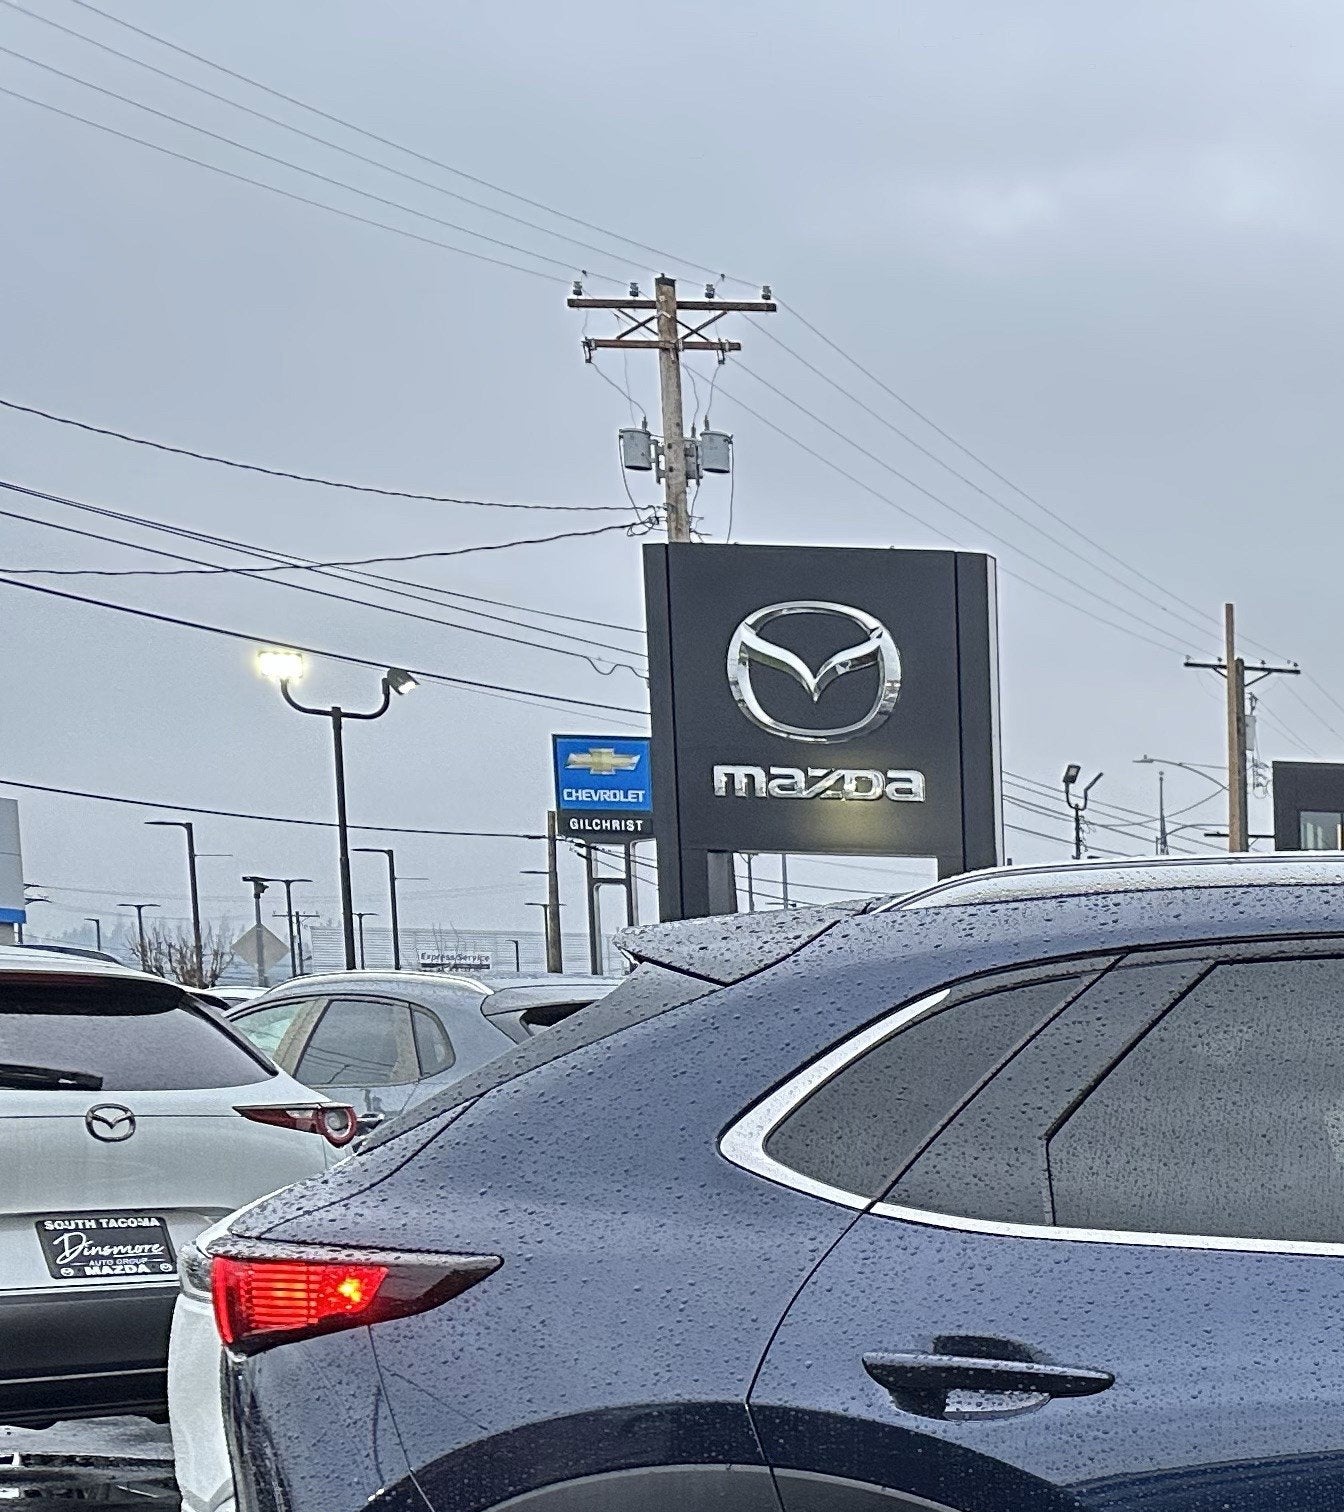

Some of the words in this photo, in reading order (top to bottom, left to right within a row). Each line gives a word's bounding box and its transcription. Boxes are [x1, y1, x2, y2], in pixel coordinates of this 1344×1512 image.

[713, 764, 926, 802] mazda
[563, 788, 646, 803] CHEVROLET
[569, 817, 644, 832] GILCHRIST
[44, 1219, 97, 1230] SOUTH
[99, 1217, 160, 1228] TACOMA
[53, 1231, 164, 1265] Dinsmore
[84, 1265, 151, 1276] MAZDA
[89, 1259, 114, 1267] AUTO
